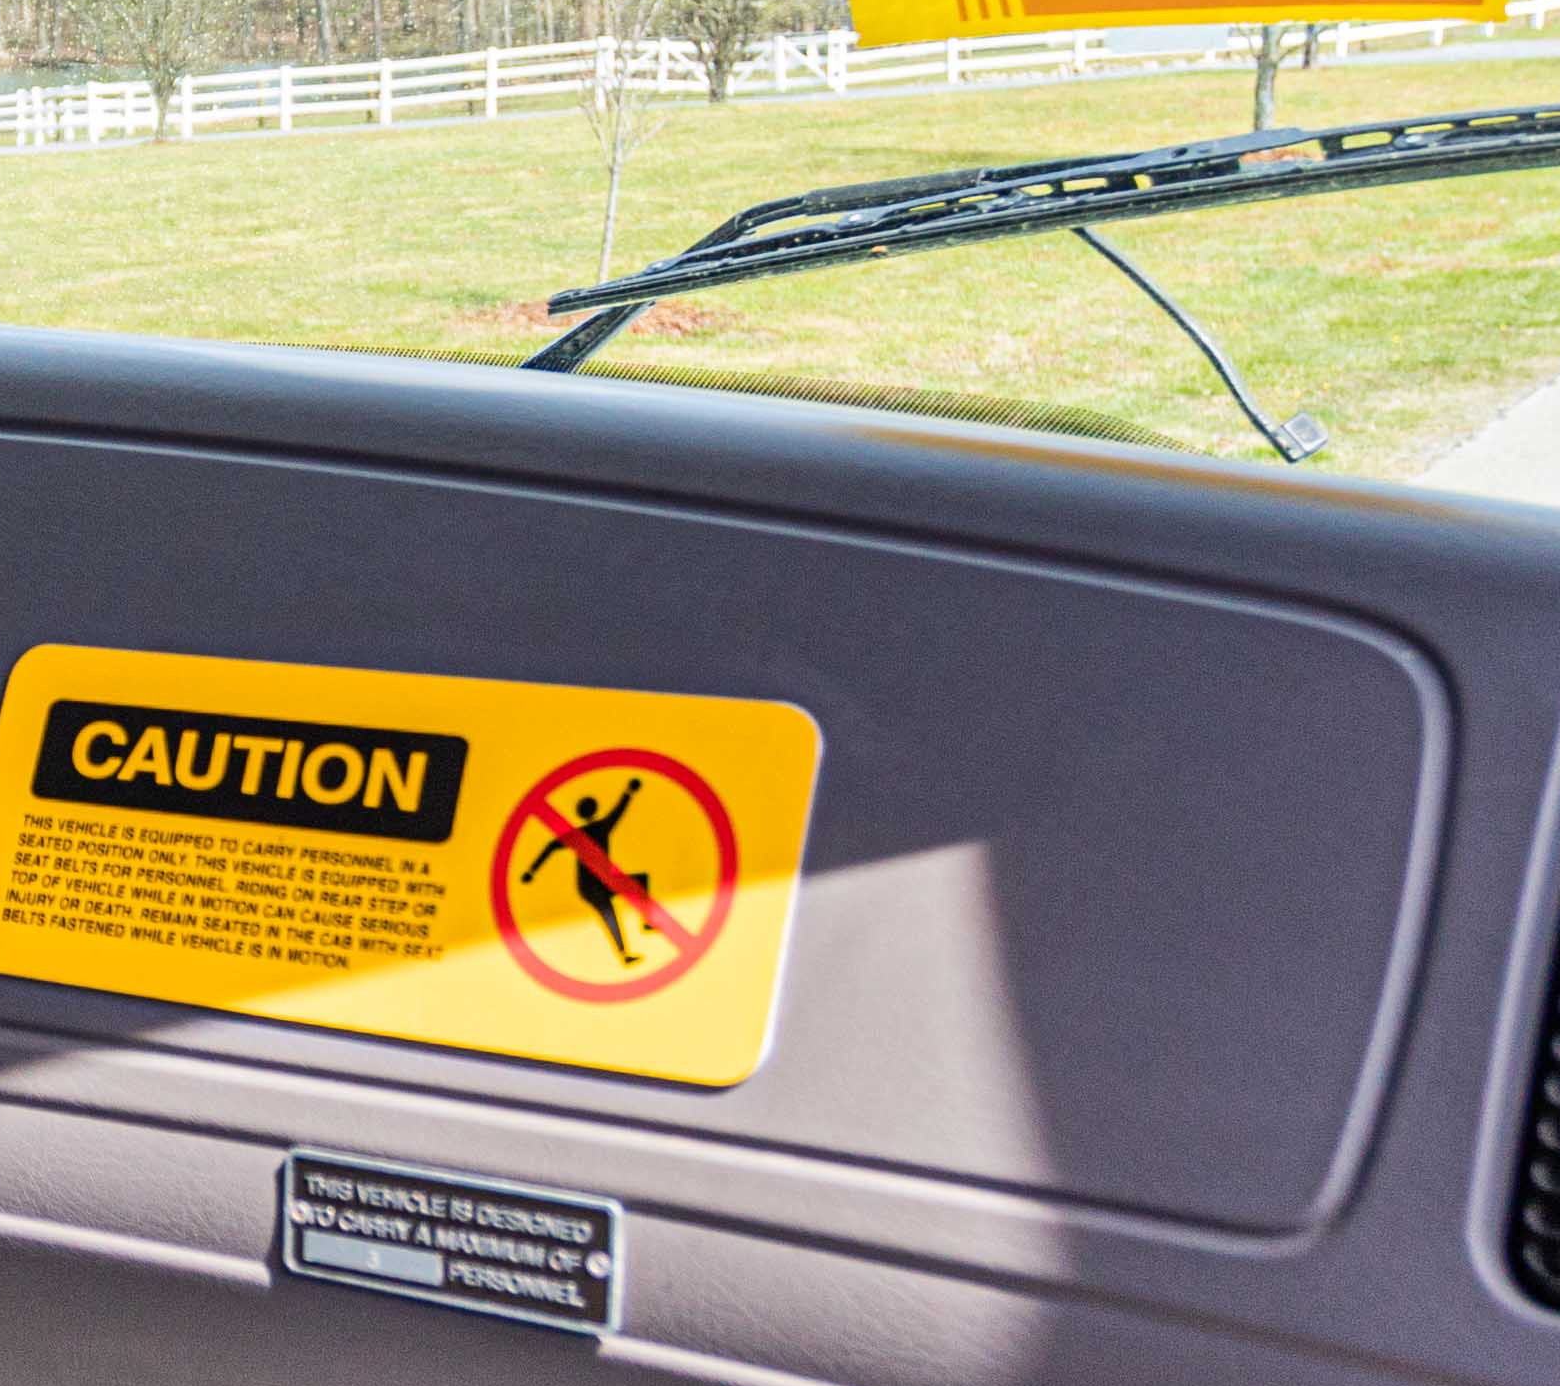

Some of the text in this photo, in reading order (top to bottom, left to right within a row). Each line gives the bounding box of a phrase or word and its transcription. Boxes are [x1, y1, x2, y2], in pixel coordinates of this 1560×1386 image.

[71, 720, 429, 813] CAUTION
[18, 833, 72, 852] SEATED
[77, 840, 143, 861] POSITION
[195, 855, 227, 871] THIS
[232, 861, 296, 880] VEHICLE
[302, 869, 314, 882] IS
[319, 871, 400, 893] EQUIPPED
[406, 882, 446, 896] WITH
[24, 814, 430, 875] THIS VEHICLE IS EQUIPPED TO CARRY PERSONNEL IN A
[11, 870, 429, 939] TOP OF VEHICLE WHILE IN MOTION CAN CAUSE SERIOUS
[14, 852, 50, 867] SEAT
[53, 857, 97, 874] BELTS
[102, 864, 131, 878] FOR
[235, 880, 287, 900] RIDING
[292, 888, 314, 903] ON
[319, 892, 363, 907] REAR
[368, 897, 409, 914] STEP
[413, 904, 437, 918] OR
[1, 908, 45, 927] BELTS
[49, 915, 125, 939] FASTENED
[130, 926, 176, 946] WHILE
[180, 933, 244, 955] VEHICLE
[248, 943, 262, 957] IS
[267, 945, 282, 960] IN
[6, 889, 55, 907] INJURY
[59, 897, 80, 911] OR
[140, 908, 197, 927] REMAIN
[201, 916, 261, 937] SEATED
[266, 925, 280, 938] IN
[286, 927, 314, 945] THE
[319, 932, 353, 949] CAB
[359, 938, 398, 953] WITH
[304, 1172, 593, 1244] THIS VEHICLE IS DESIGNED
[339, 1209, 412, 1241] CARRY
[415, 1221, 431, 1246] A
[434, 1227, 546, 1266] MAXIMUM
[548, 1248, 581, 1273] OF
[448, 1261, 586, 1308] PERSONNEL
